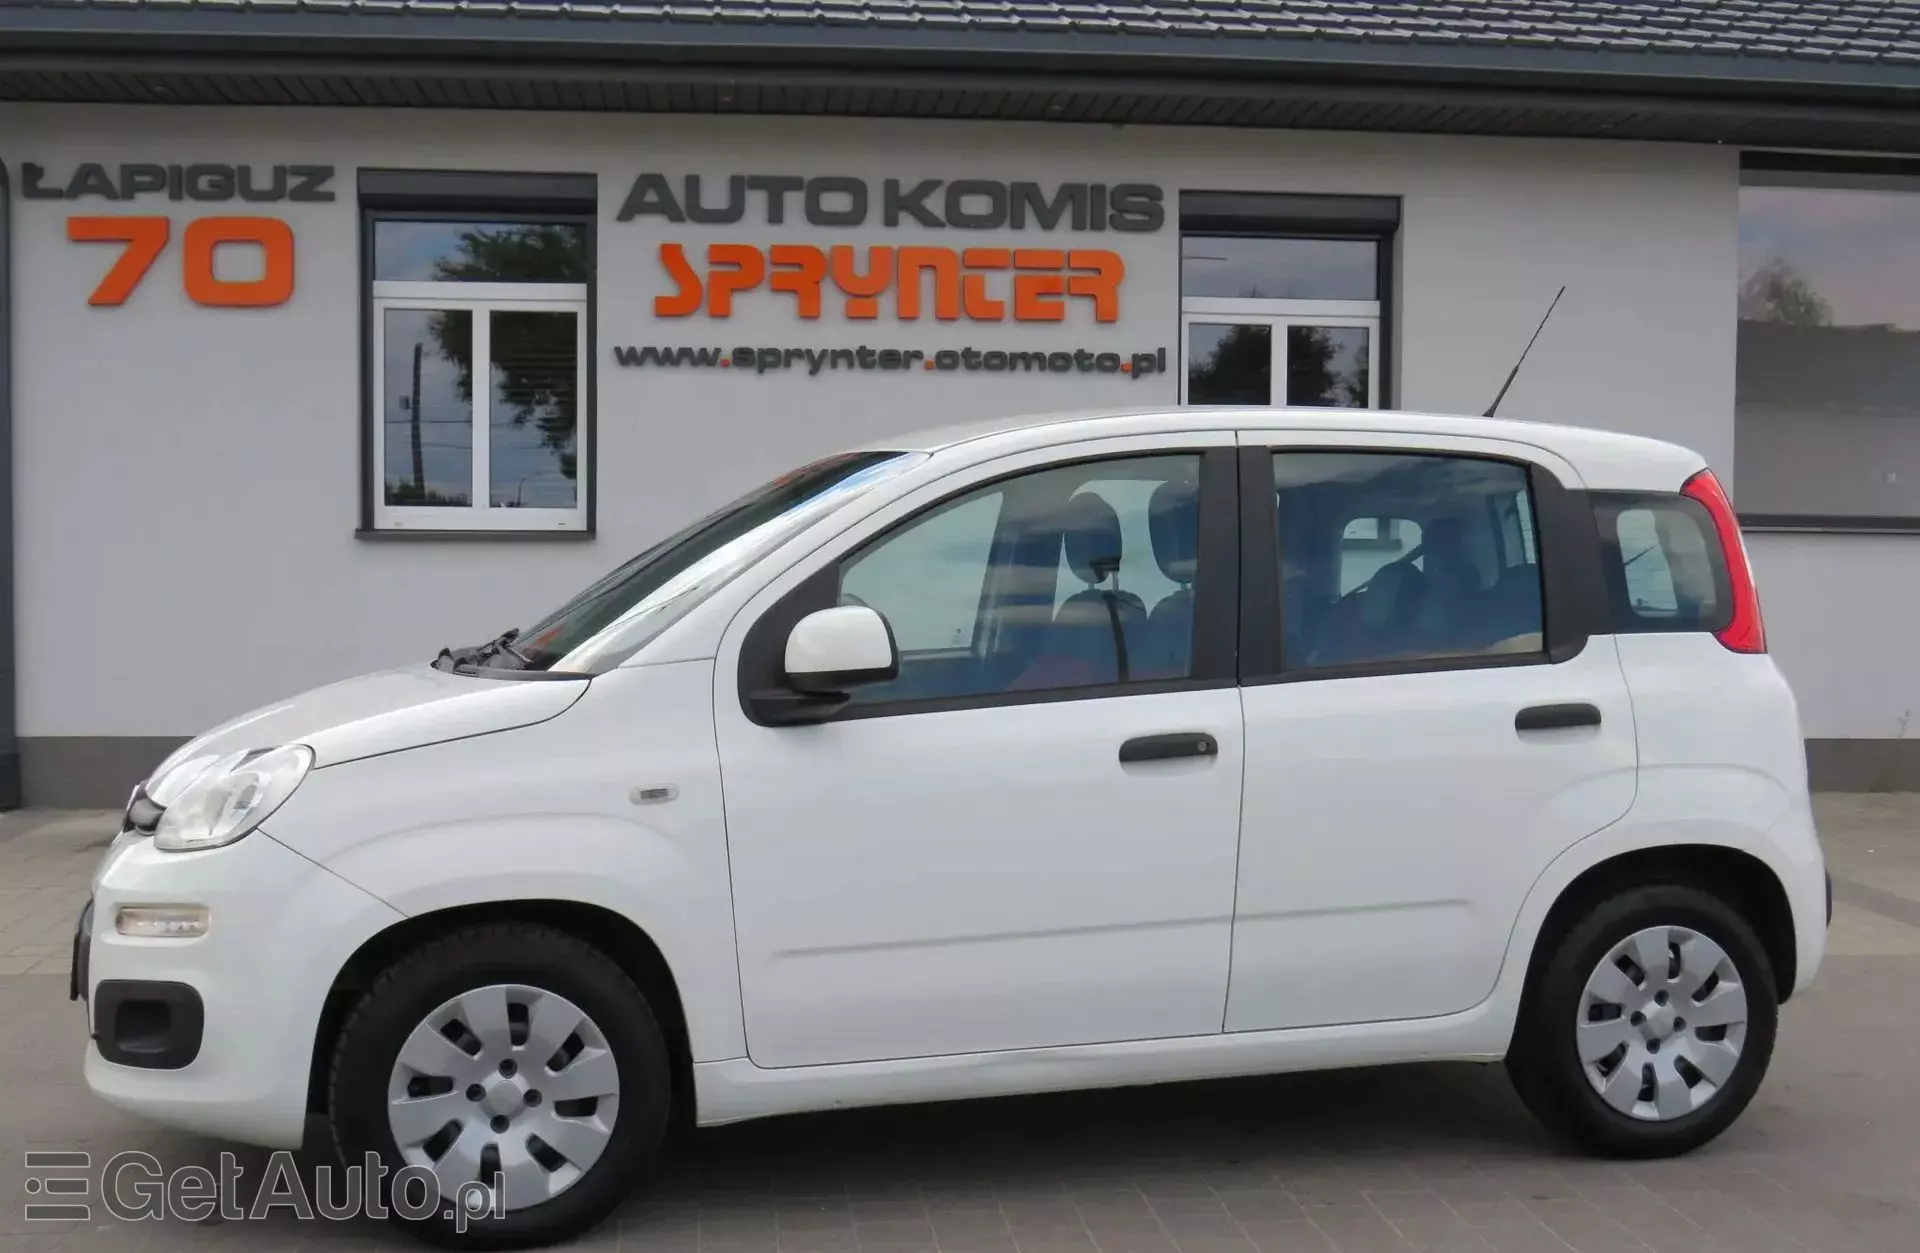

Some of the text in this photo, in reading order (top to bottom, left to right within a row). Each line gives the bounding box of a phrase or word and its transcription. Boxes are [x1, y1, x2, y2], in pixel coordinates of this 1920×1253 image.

[22, 163, 335, 202] ŁAPIGUZ
[617, 173, 1164, 232] AUTO KOMIS
[66, 216, 295, 307] 70
[654, 243, 1125, 322] SPRYNTER
[613, 345, 1167, 378] www.sprynter.otomoto.pl
